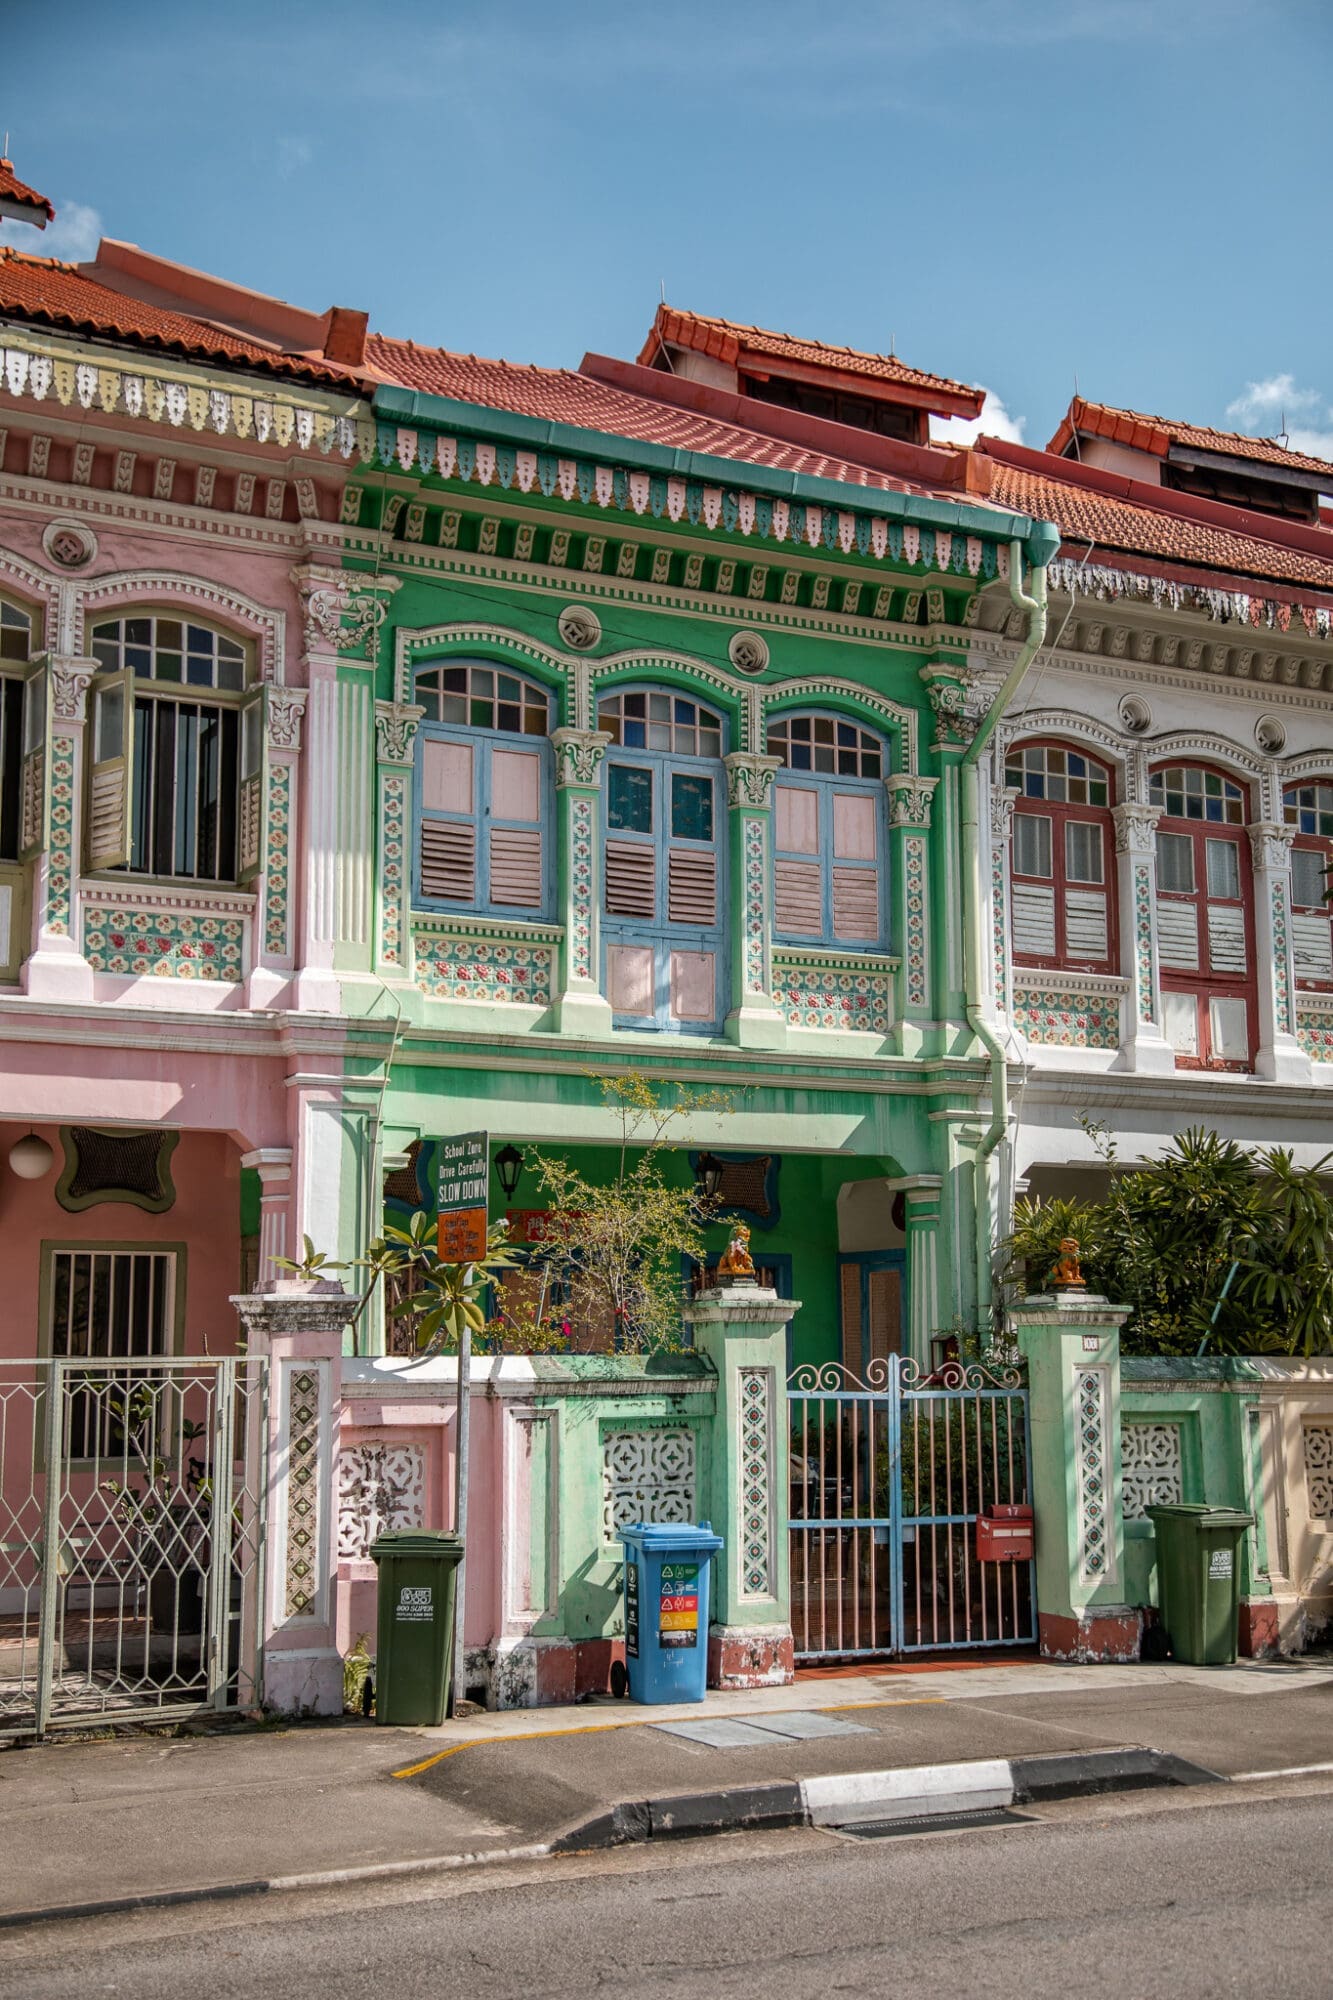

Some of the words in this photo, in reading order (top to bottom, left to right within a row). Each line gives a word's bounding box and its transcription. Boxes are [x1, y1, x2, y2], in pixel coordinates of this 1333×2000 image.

[445, 1142, 464, 1158] School
[467, 1141, 481, 1155] Zone
[440, 1165, 455, 1179] Drive
[458, 1159, 486, 1176] Carefully
[439, 1182, 460, 1203] SLOW
[463, 1179, 486, 1200] DOWN
[1007, 1506, 1018, 1516] 17
